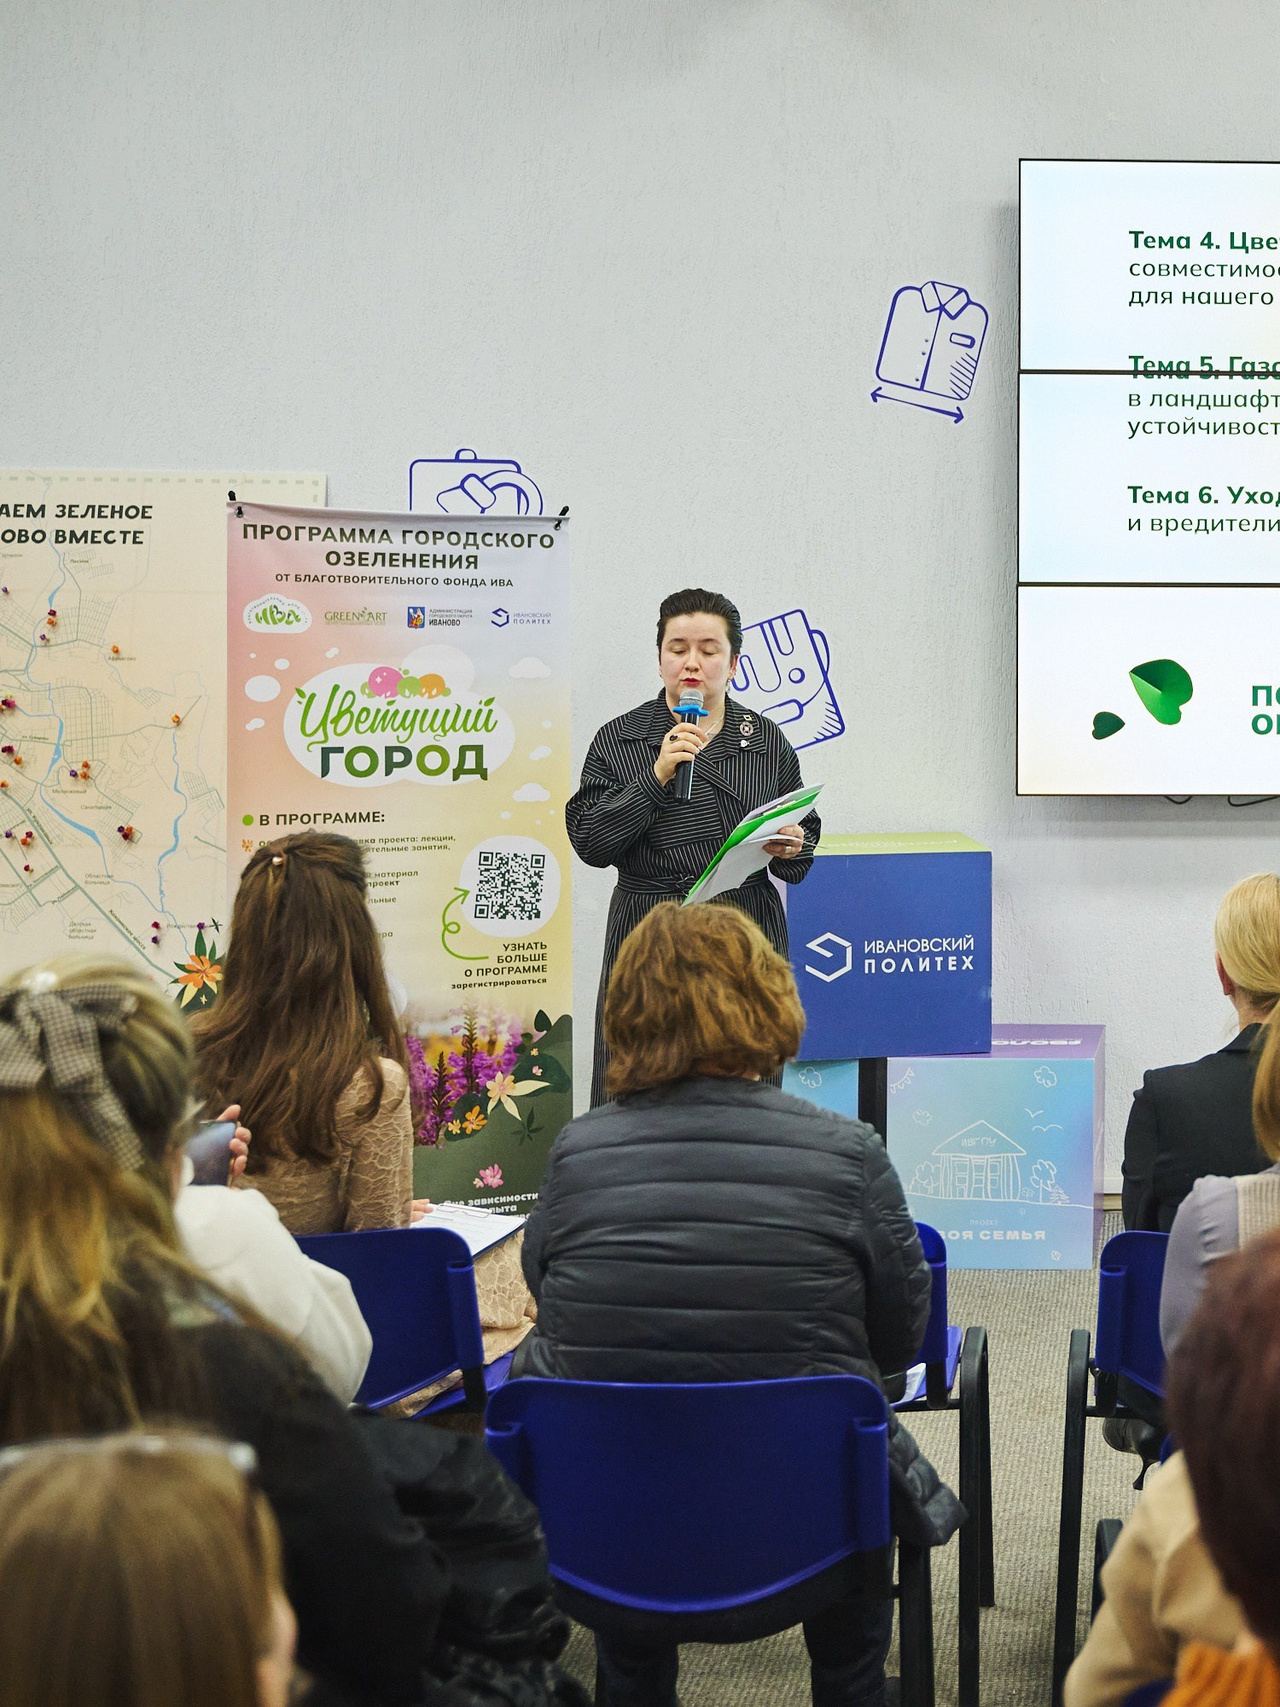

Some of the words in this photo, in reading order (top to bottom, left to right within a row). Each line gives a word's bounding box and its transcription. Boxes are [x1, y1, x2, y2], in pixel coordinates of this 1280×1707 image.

[1129, 231, 1191, 249] Тема
[1200, 231, 1220, 249] 4.
[1129, 290, 1173, 307] для
[1182, 290, 1274, 306] нашего
[1129, 355, 1191, 379] Тема
[1200, 355, 1220, 379] 5.
[1128, 393, 1141, 407] в
[1128, 486, 1189, 504] Тема
[1198, 486, 1219, 504] 6.
[55, 504, 153, 519] ЗЕЛЕНОЕ
[1128, 518, 1141, 532] и
[1150, 518, 1280, 536] вредители
[54, 529, 144, 545] ВМЕСТЕ
[242, 523, 393, 545] ПРОГРАММА
[402, 528, 555, 550] ГОРОДСКОГО
[325, 550, 479, 570] ОЗЕЛЕНЕНИЯ
[275, 573, 289, 583] ОТ
[294, 574, 439, 586] БЛАГОТВОРИТЕЛЬНОГО
[443, 576, 487, 588] ФОНДА
[490, 578, 514, 587] ИВА
[324, 611, 360, 621] GREEN
[367, 611, 388, 621] ART
[429, 619, 461, 627] ИВАНОВО
[296, 684, 498, 752] Цветущий
[321, 744, 488, 781] ГОРОД
[259, 814, 270, 826] В
[276, 811, 385, 825] ПРОГРАММЕ:
[378, 837, 418, 845] проекта:
[420, 835, 456, 843] лекции,
[374, 870, 419, 879] материал
[503, 942, 547, 952] УЗНАТЬ
[864, 934, 974, 954] ИВАНОВСКИЙ
[497, 953, 547, 964] БОЛЬШЕ
[864, 955, 974, 974] ПОЛИТЕХ
[464, 969, 473, 978] О
[476, 964, 547, 977] ПРОГРАММЕ
[451, 978, 547, 990] зарегистрироваться
[468, 1192, 539, 1206] зависимости
[489, 1204, 518, 1214] пыта
[979, 1230, 1046, 1240] СЕМЬЯ
